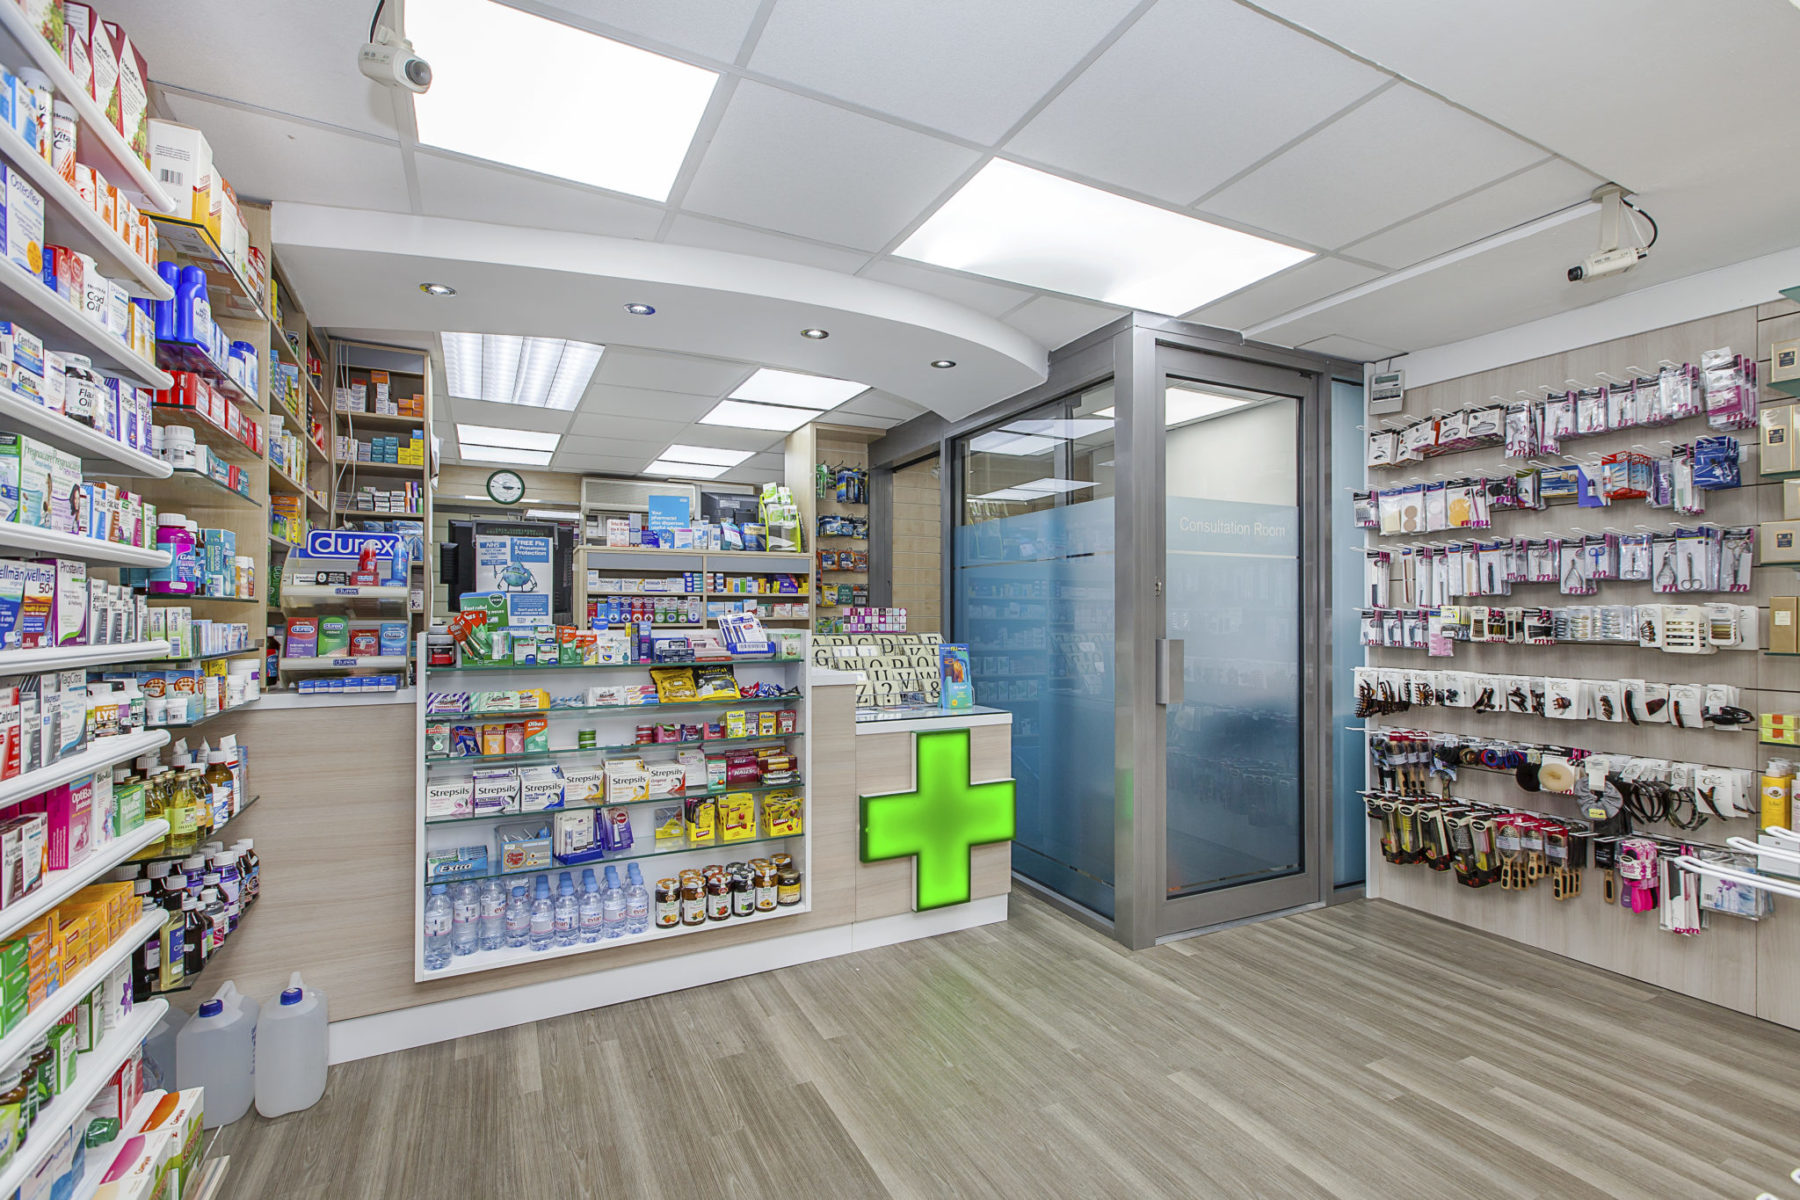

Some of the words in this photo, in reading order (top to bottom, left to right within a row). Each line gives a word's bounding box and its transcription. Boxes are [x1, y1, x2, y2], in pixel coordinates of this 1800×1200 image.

[87, 292, 104, 304] Cod
[87, 302, 100, 312] Oil
[79, 398, 92, 408] Oil
[1179, 516, 1251, 536] Consultation
[1254, 522, 1286, 537] Room
[314, 532, 394, 554] durex
[38, 583, 54, 594] 50+
[880, 638, 894, 654] D
[814, 649, 829, 667] G
[844, 660, 858, 669] N
[898, 672, 912, 690] V
[856, 684, 868, 704] Z
[882, 682, 894, 703] ?
[930, 680, 940, 698] &
[651, 769, 683, 777] Strepsils
[567, 774, 601, 783] Strepsils
[612, 776, 646, 785] Strepsils
[430, 787, 470, 797] Strepsils
[478, 785, 516, 795] Strepsils
[524, 783, 562, 792] Strepsils
[440, 863, 472, 873] Extra
